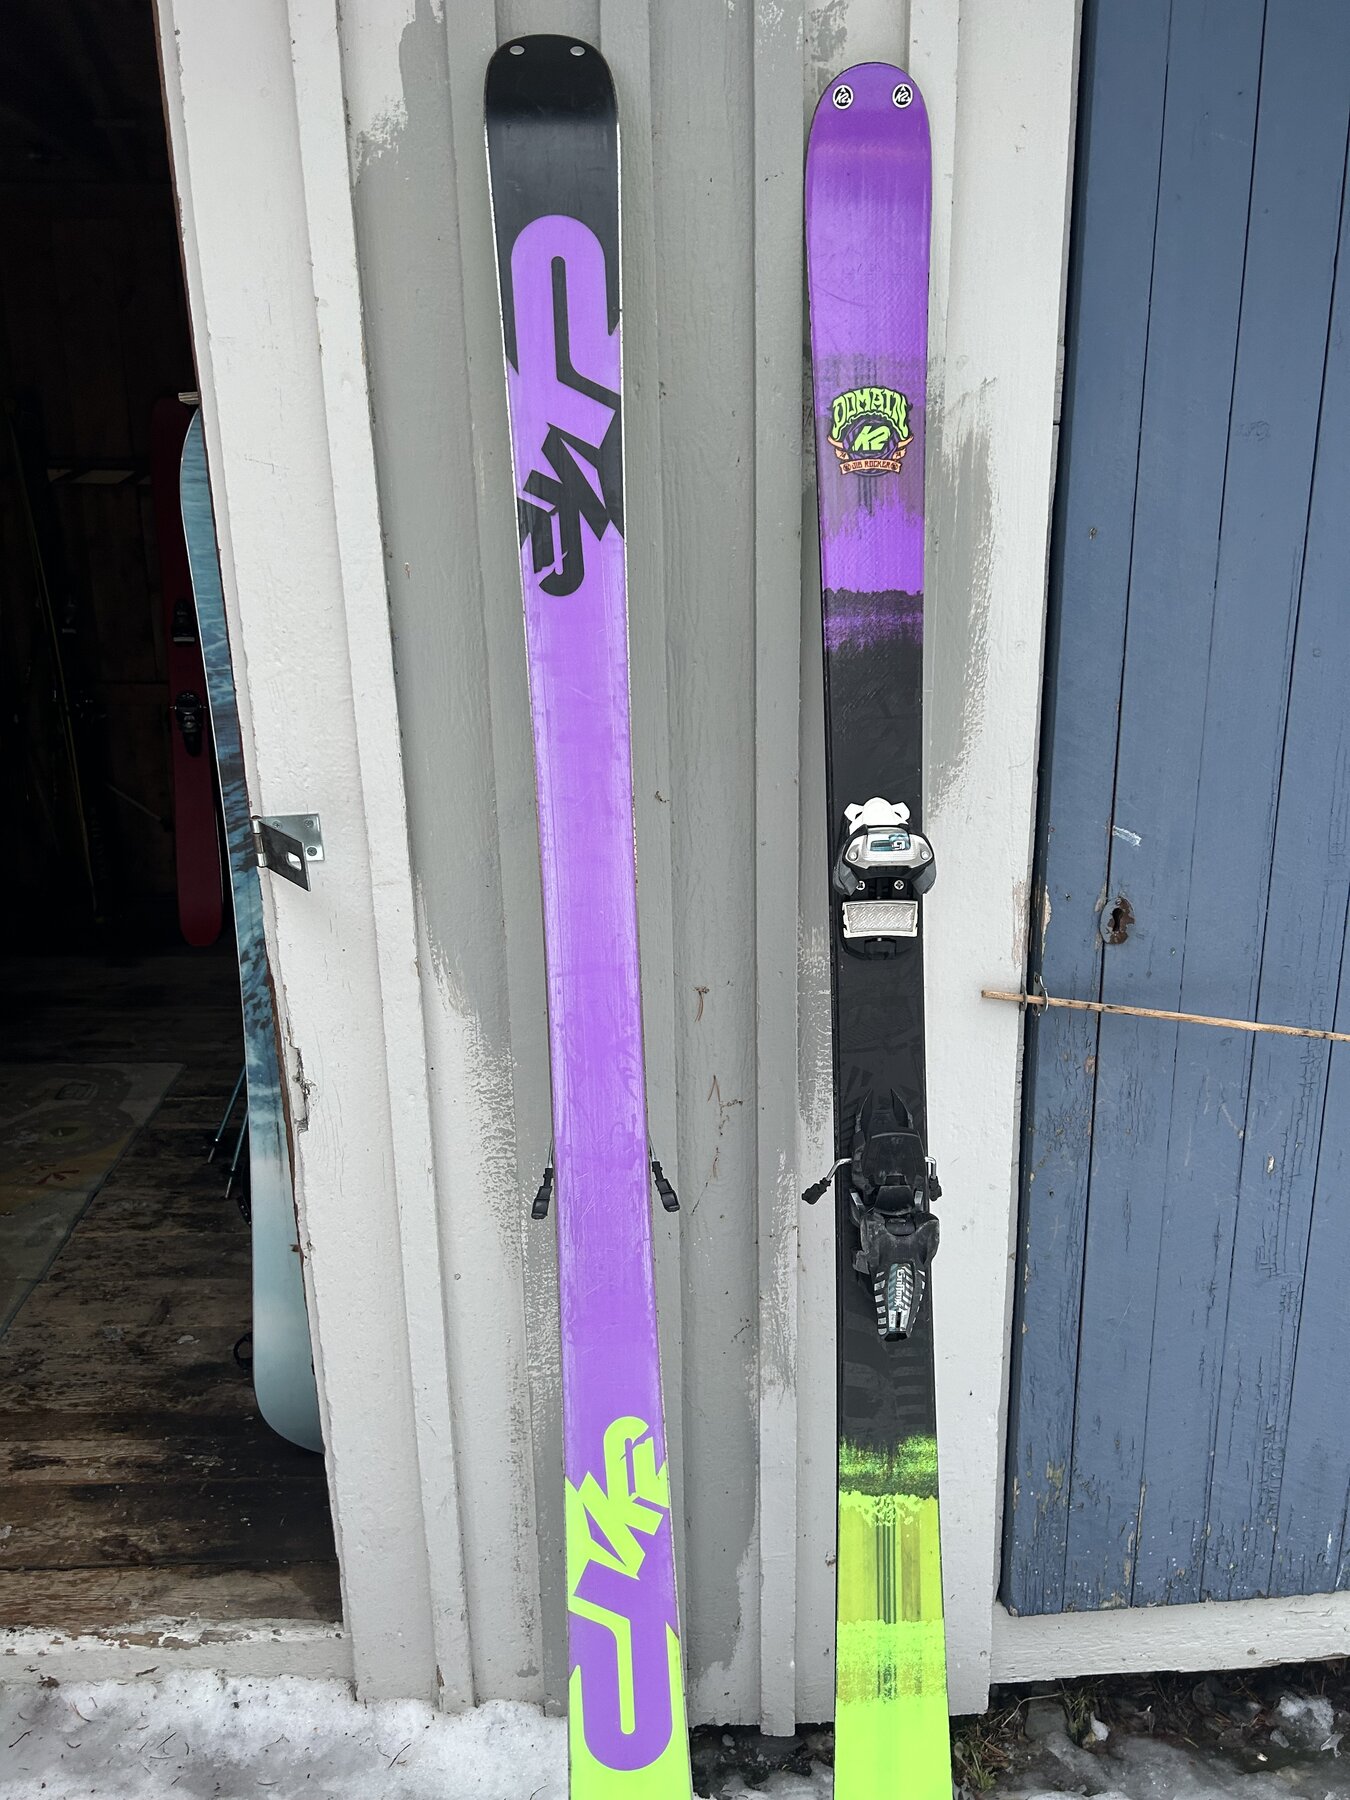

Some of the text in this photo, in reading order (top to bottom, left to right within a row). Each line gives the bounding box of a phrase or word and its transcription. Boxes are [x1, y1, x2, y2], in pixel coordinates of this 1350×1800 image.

[831, 387, 909, 441] DOMAIN
[851, 425, 891, 451] K2
[864, 460, 891, 469] ROCKER
